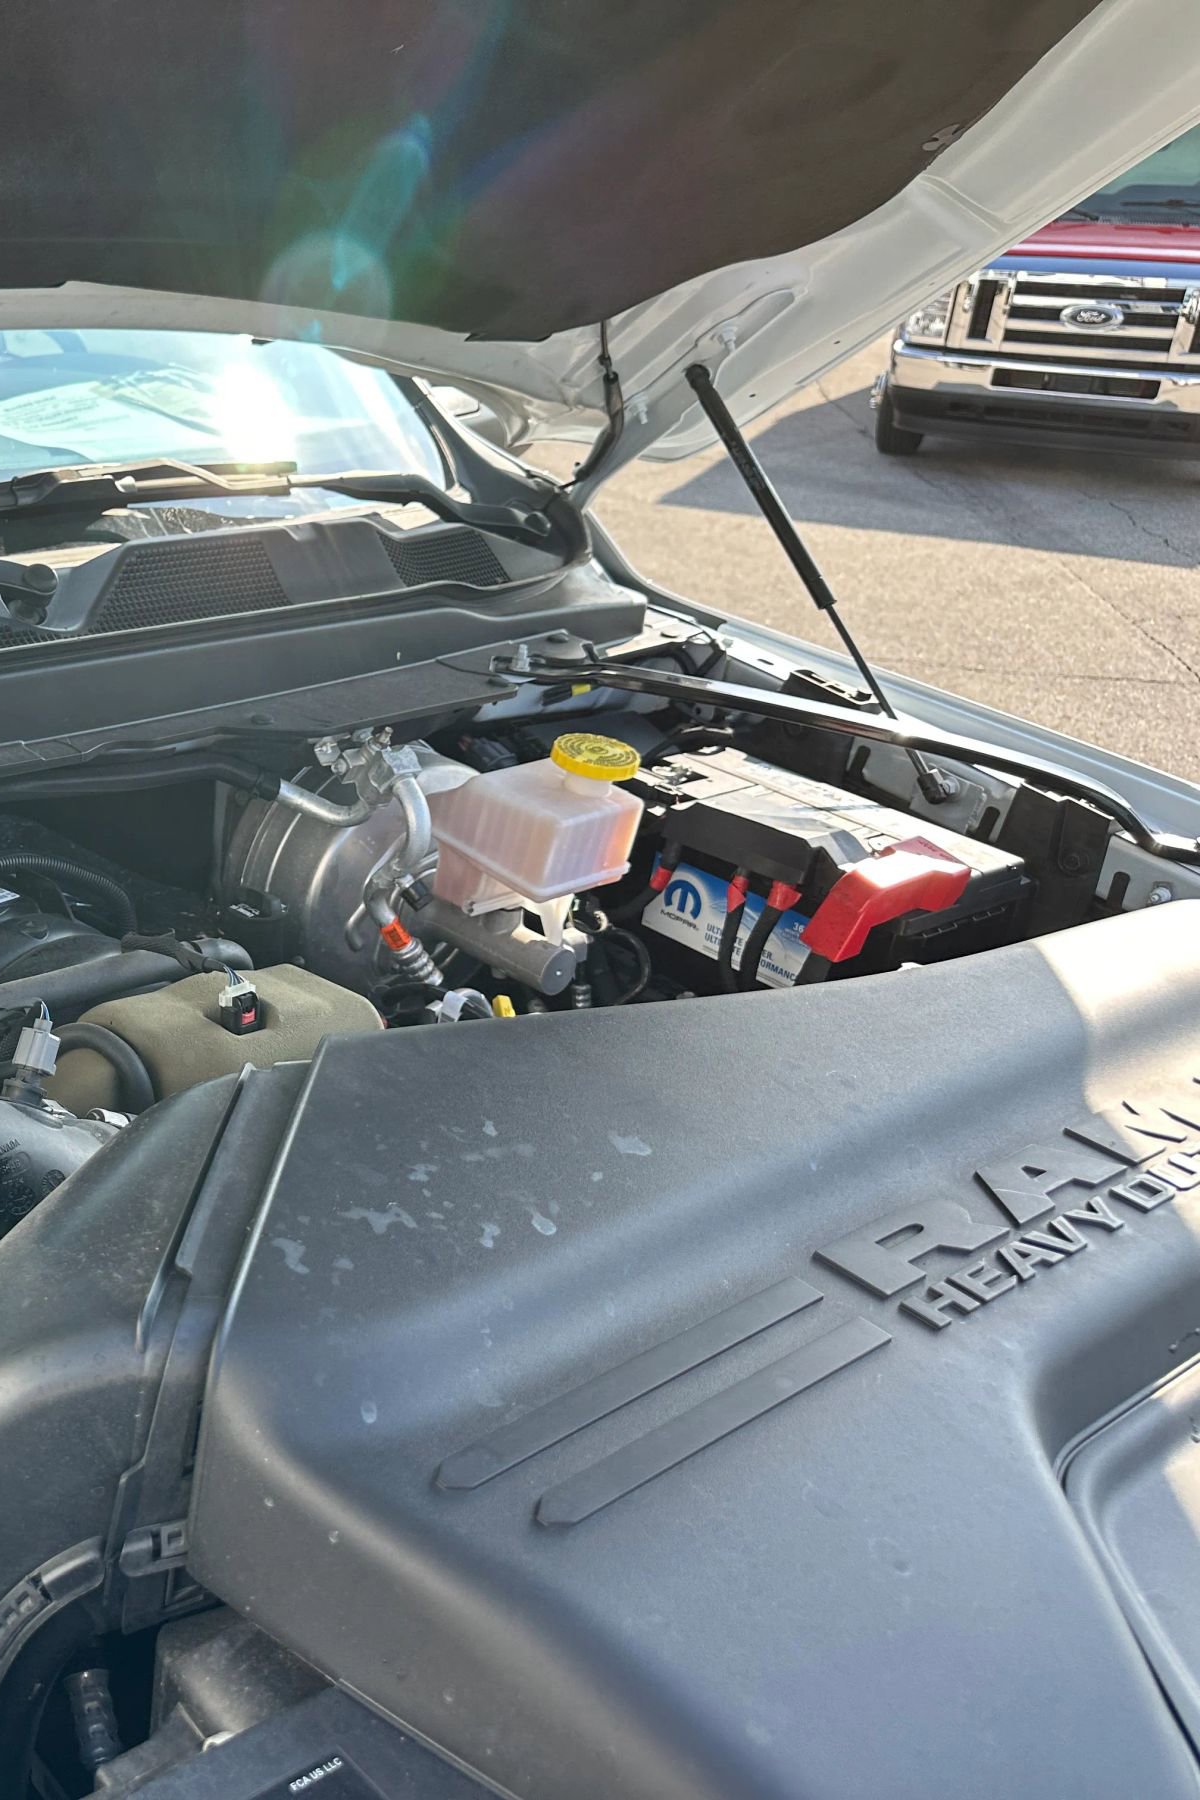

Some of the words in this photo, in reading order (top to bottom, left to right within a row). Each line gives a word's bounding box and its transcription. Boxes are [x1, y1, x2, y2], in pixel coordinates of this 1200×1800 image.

[660, 909, 697, 929] MOPAR
[812, 1084, 1200, 1299] RAM
[899, 1195, 1125, 1329] HEAVY
[290, 1776, 311, 1791] FCA
[309, 1767, 324, 1779] US
[323, 1757, 342, 1771] LLC
